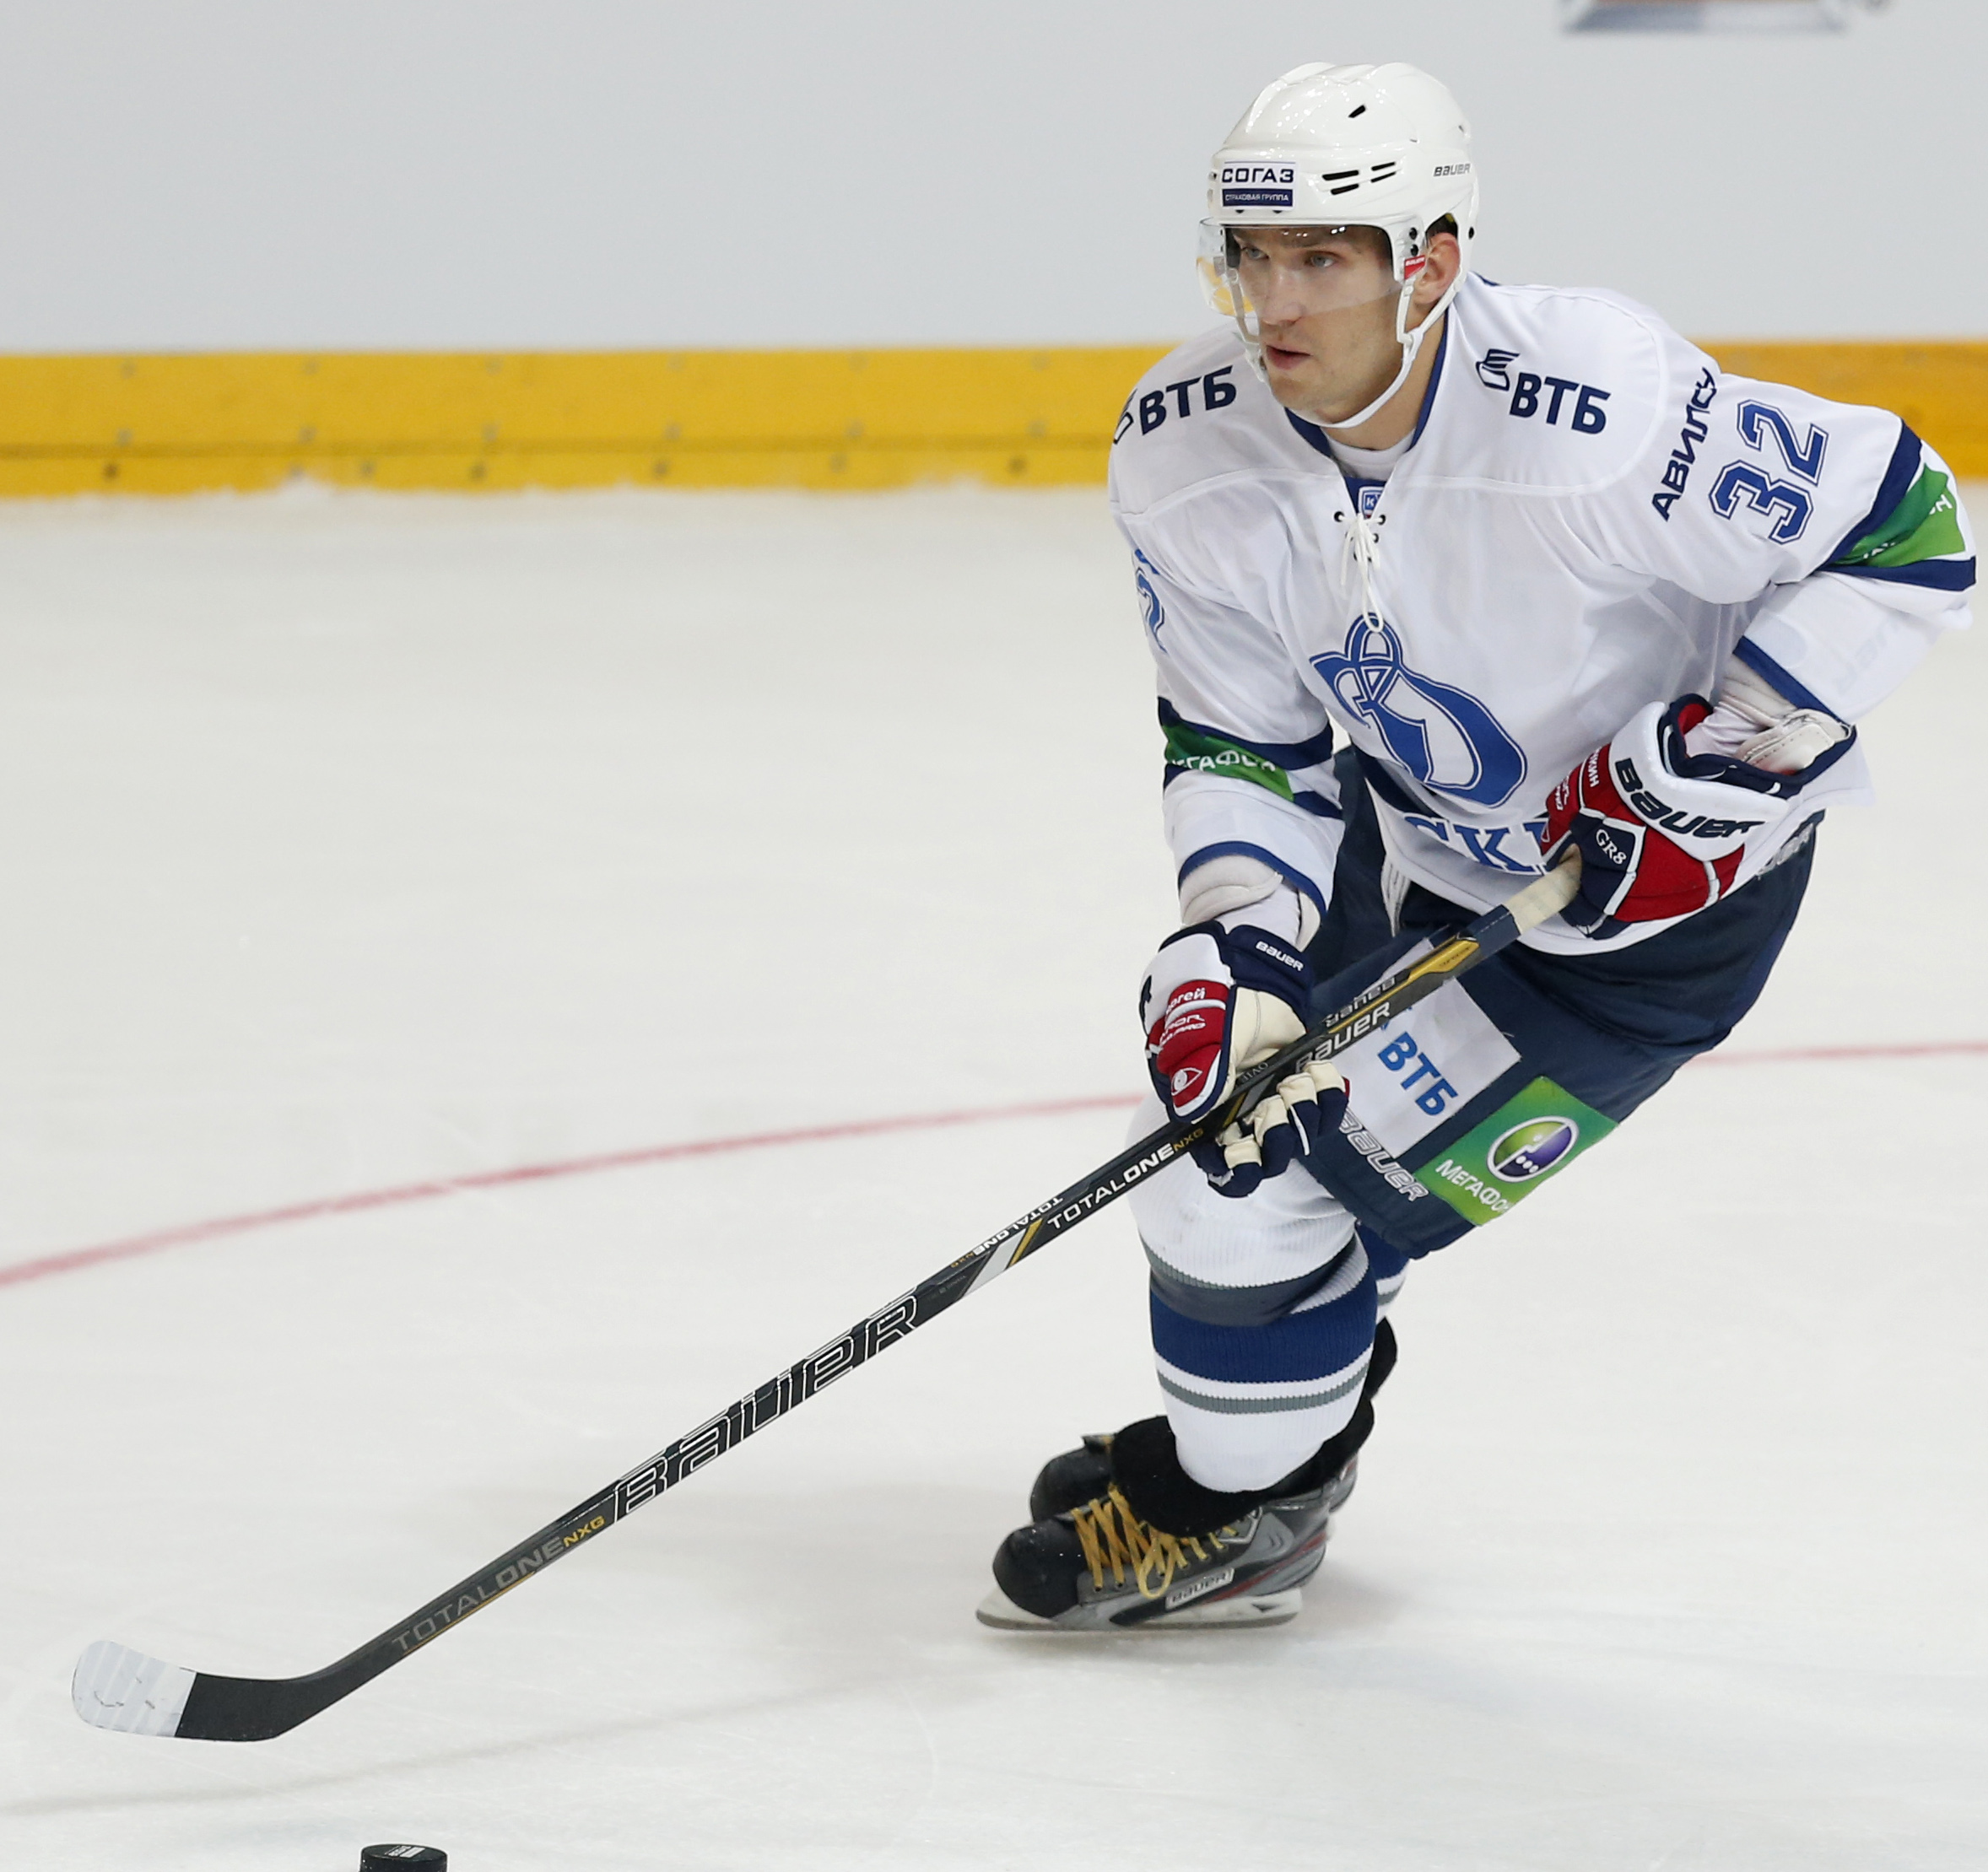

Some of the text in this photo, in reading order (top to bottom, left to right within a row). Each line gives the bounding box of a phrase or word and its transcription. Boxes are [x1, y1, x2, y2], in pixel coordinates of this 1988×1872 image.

[1221, 168, 1294, 183] СОГАЗ
[1140, 364, 1237, 436] ВТБ
[1509, 372, 1612, 434] ВТБ
[1709, 399, 1829, 545] 32
[1614, 758, 1765, 839] BAUER
[1596, 828, 1627, 865] GR8
[1255, 940, 1305, 972] BAUER
[1377, 1032, 1459, 1116] ВТБ
[614, 1286, 917, 1524] BAUER
